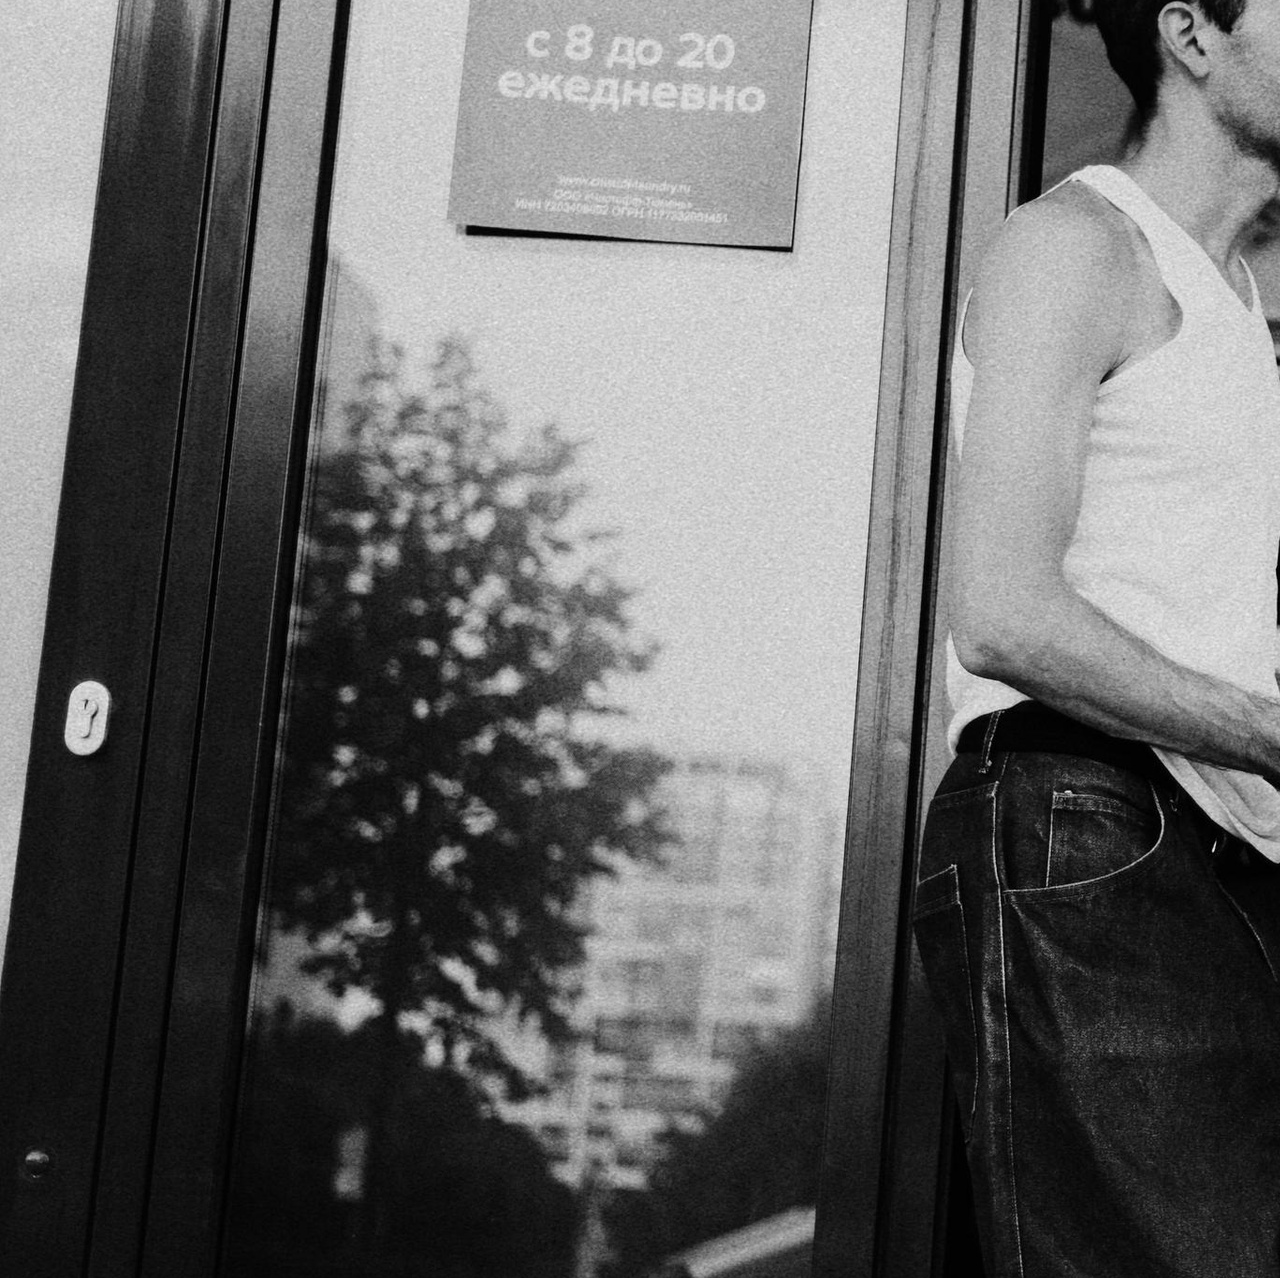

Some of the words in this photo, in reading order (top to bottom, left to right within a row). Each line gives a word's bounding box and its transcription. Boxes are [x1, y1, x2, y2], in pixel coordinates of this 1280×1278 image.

[526, 30, 552, 59] с
[564, 23, 595, 61] 8
[605, 35, 664, 70] до
[676, 32, 736, 70] 20
[498, 71, 767, 113] ежедневно
